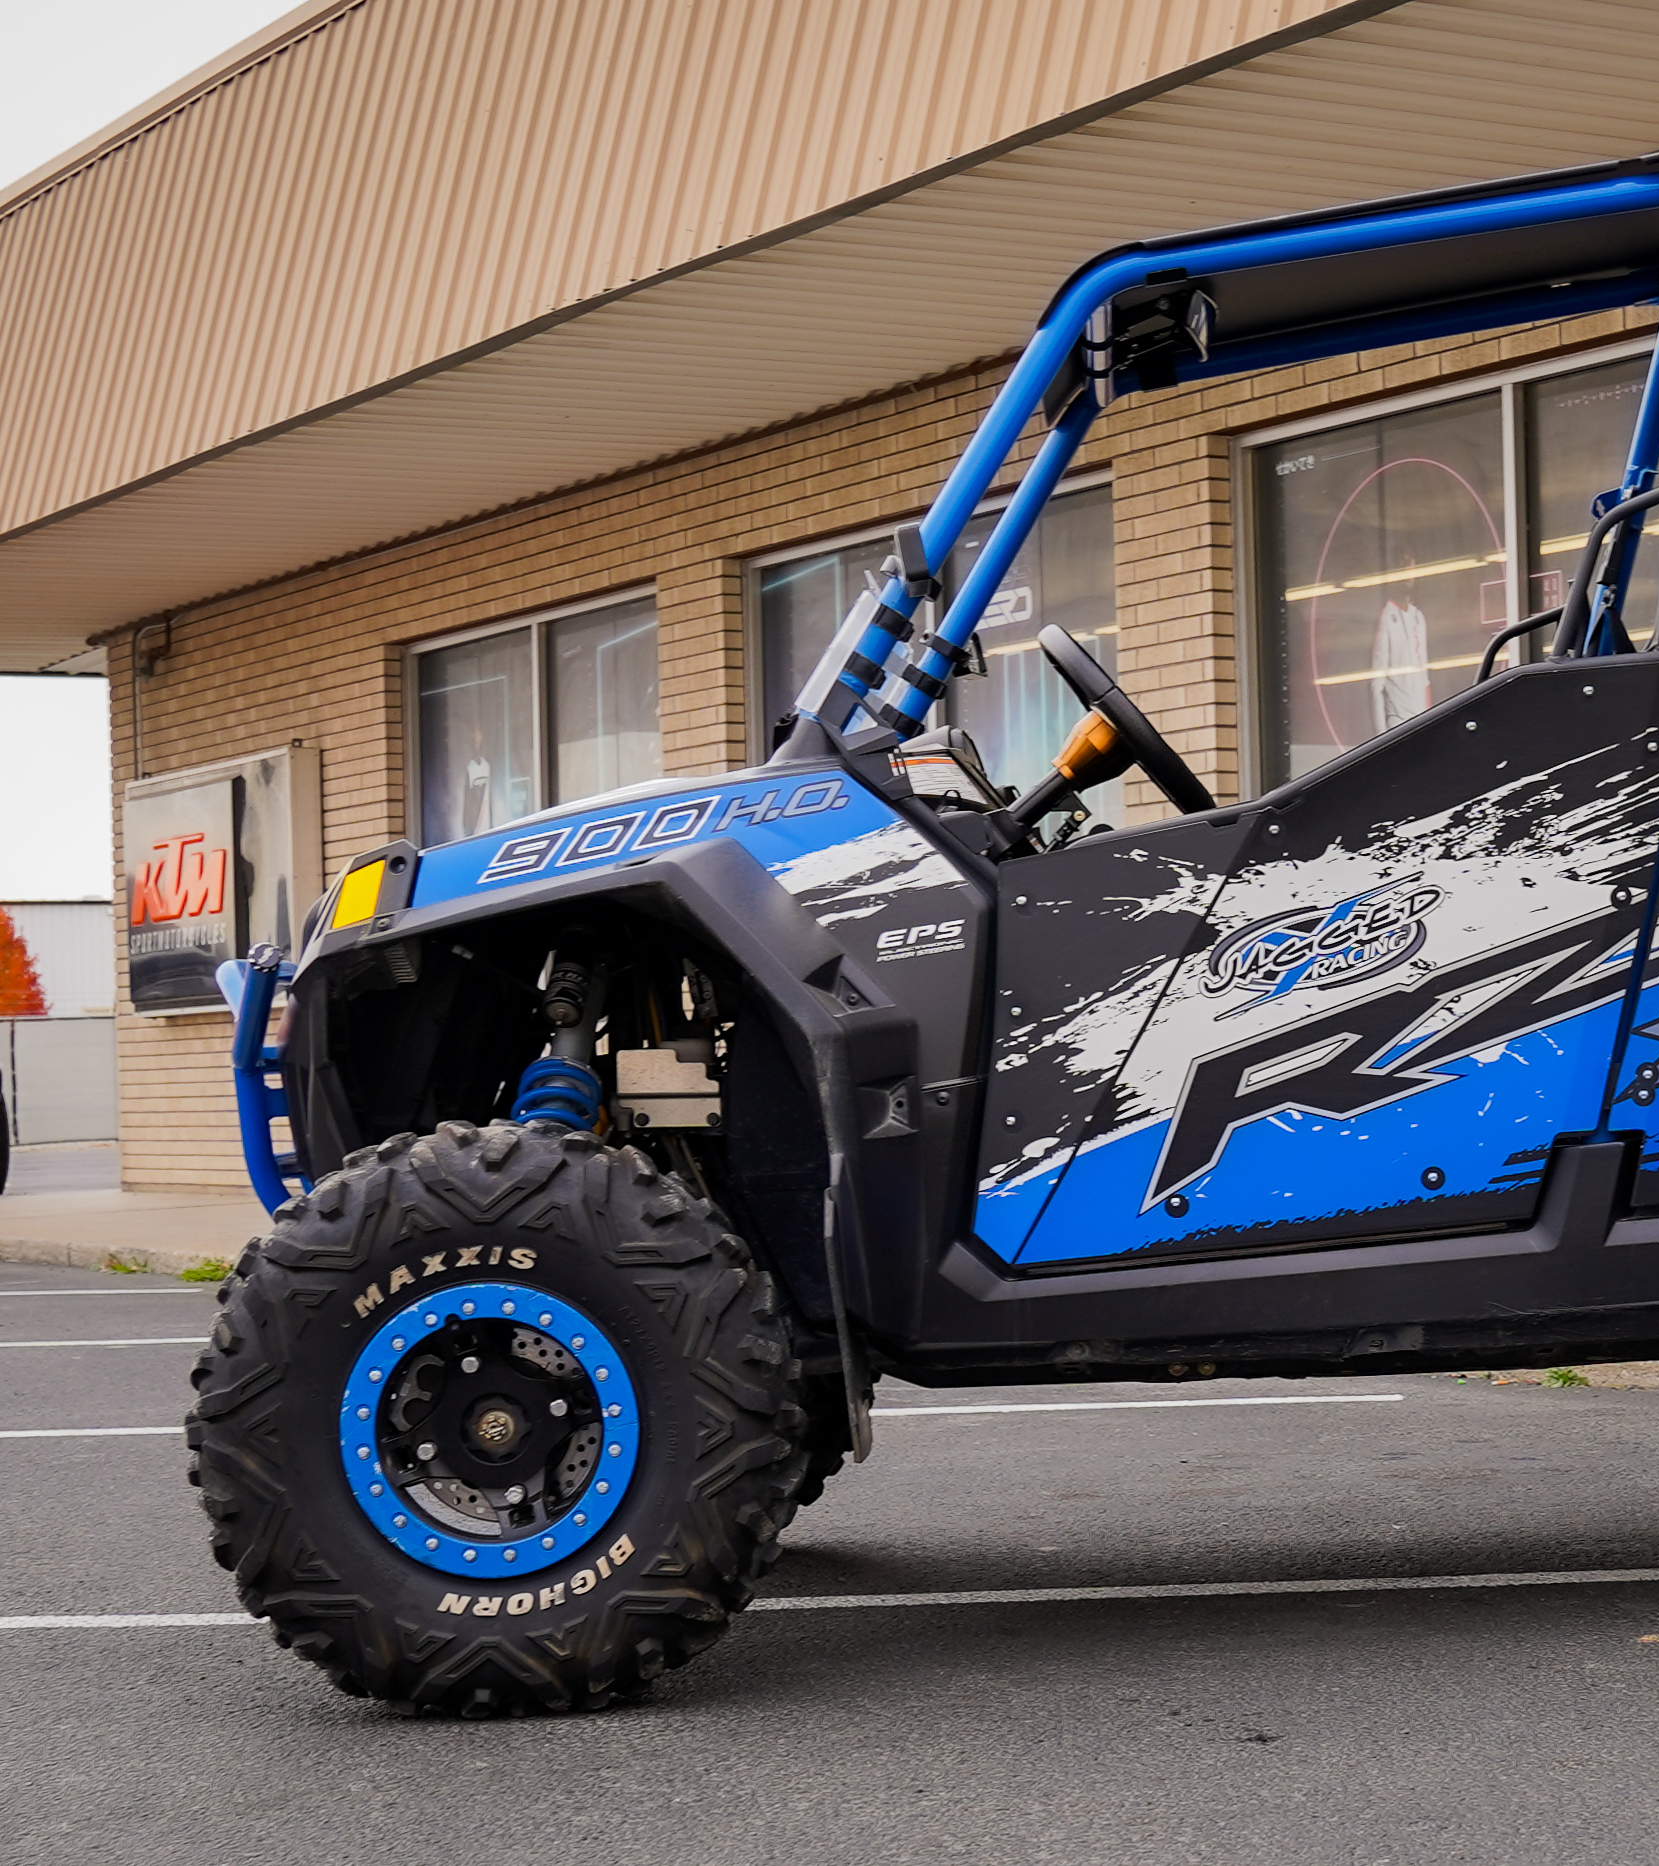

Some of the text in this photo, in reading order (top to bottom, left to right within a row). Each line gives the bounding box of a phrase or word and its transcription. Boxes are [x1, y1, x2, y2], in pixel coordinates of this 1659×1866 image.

[476, 794, 723, 885] 900
[712, 778, 851, 832] H.O.
[131, 832, 227, 927] KTM
[876, 919, 965, 949] EPS
[1311, 930, 1408, 980] RACING
[352, 1245, 538, 1319] MAXXIS
[437, 1533, 636, 1617] BIGHORN
